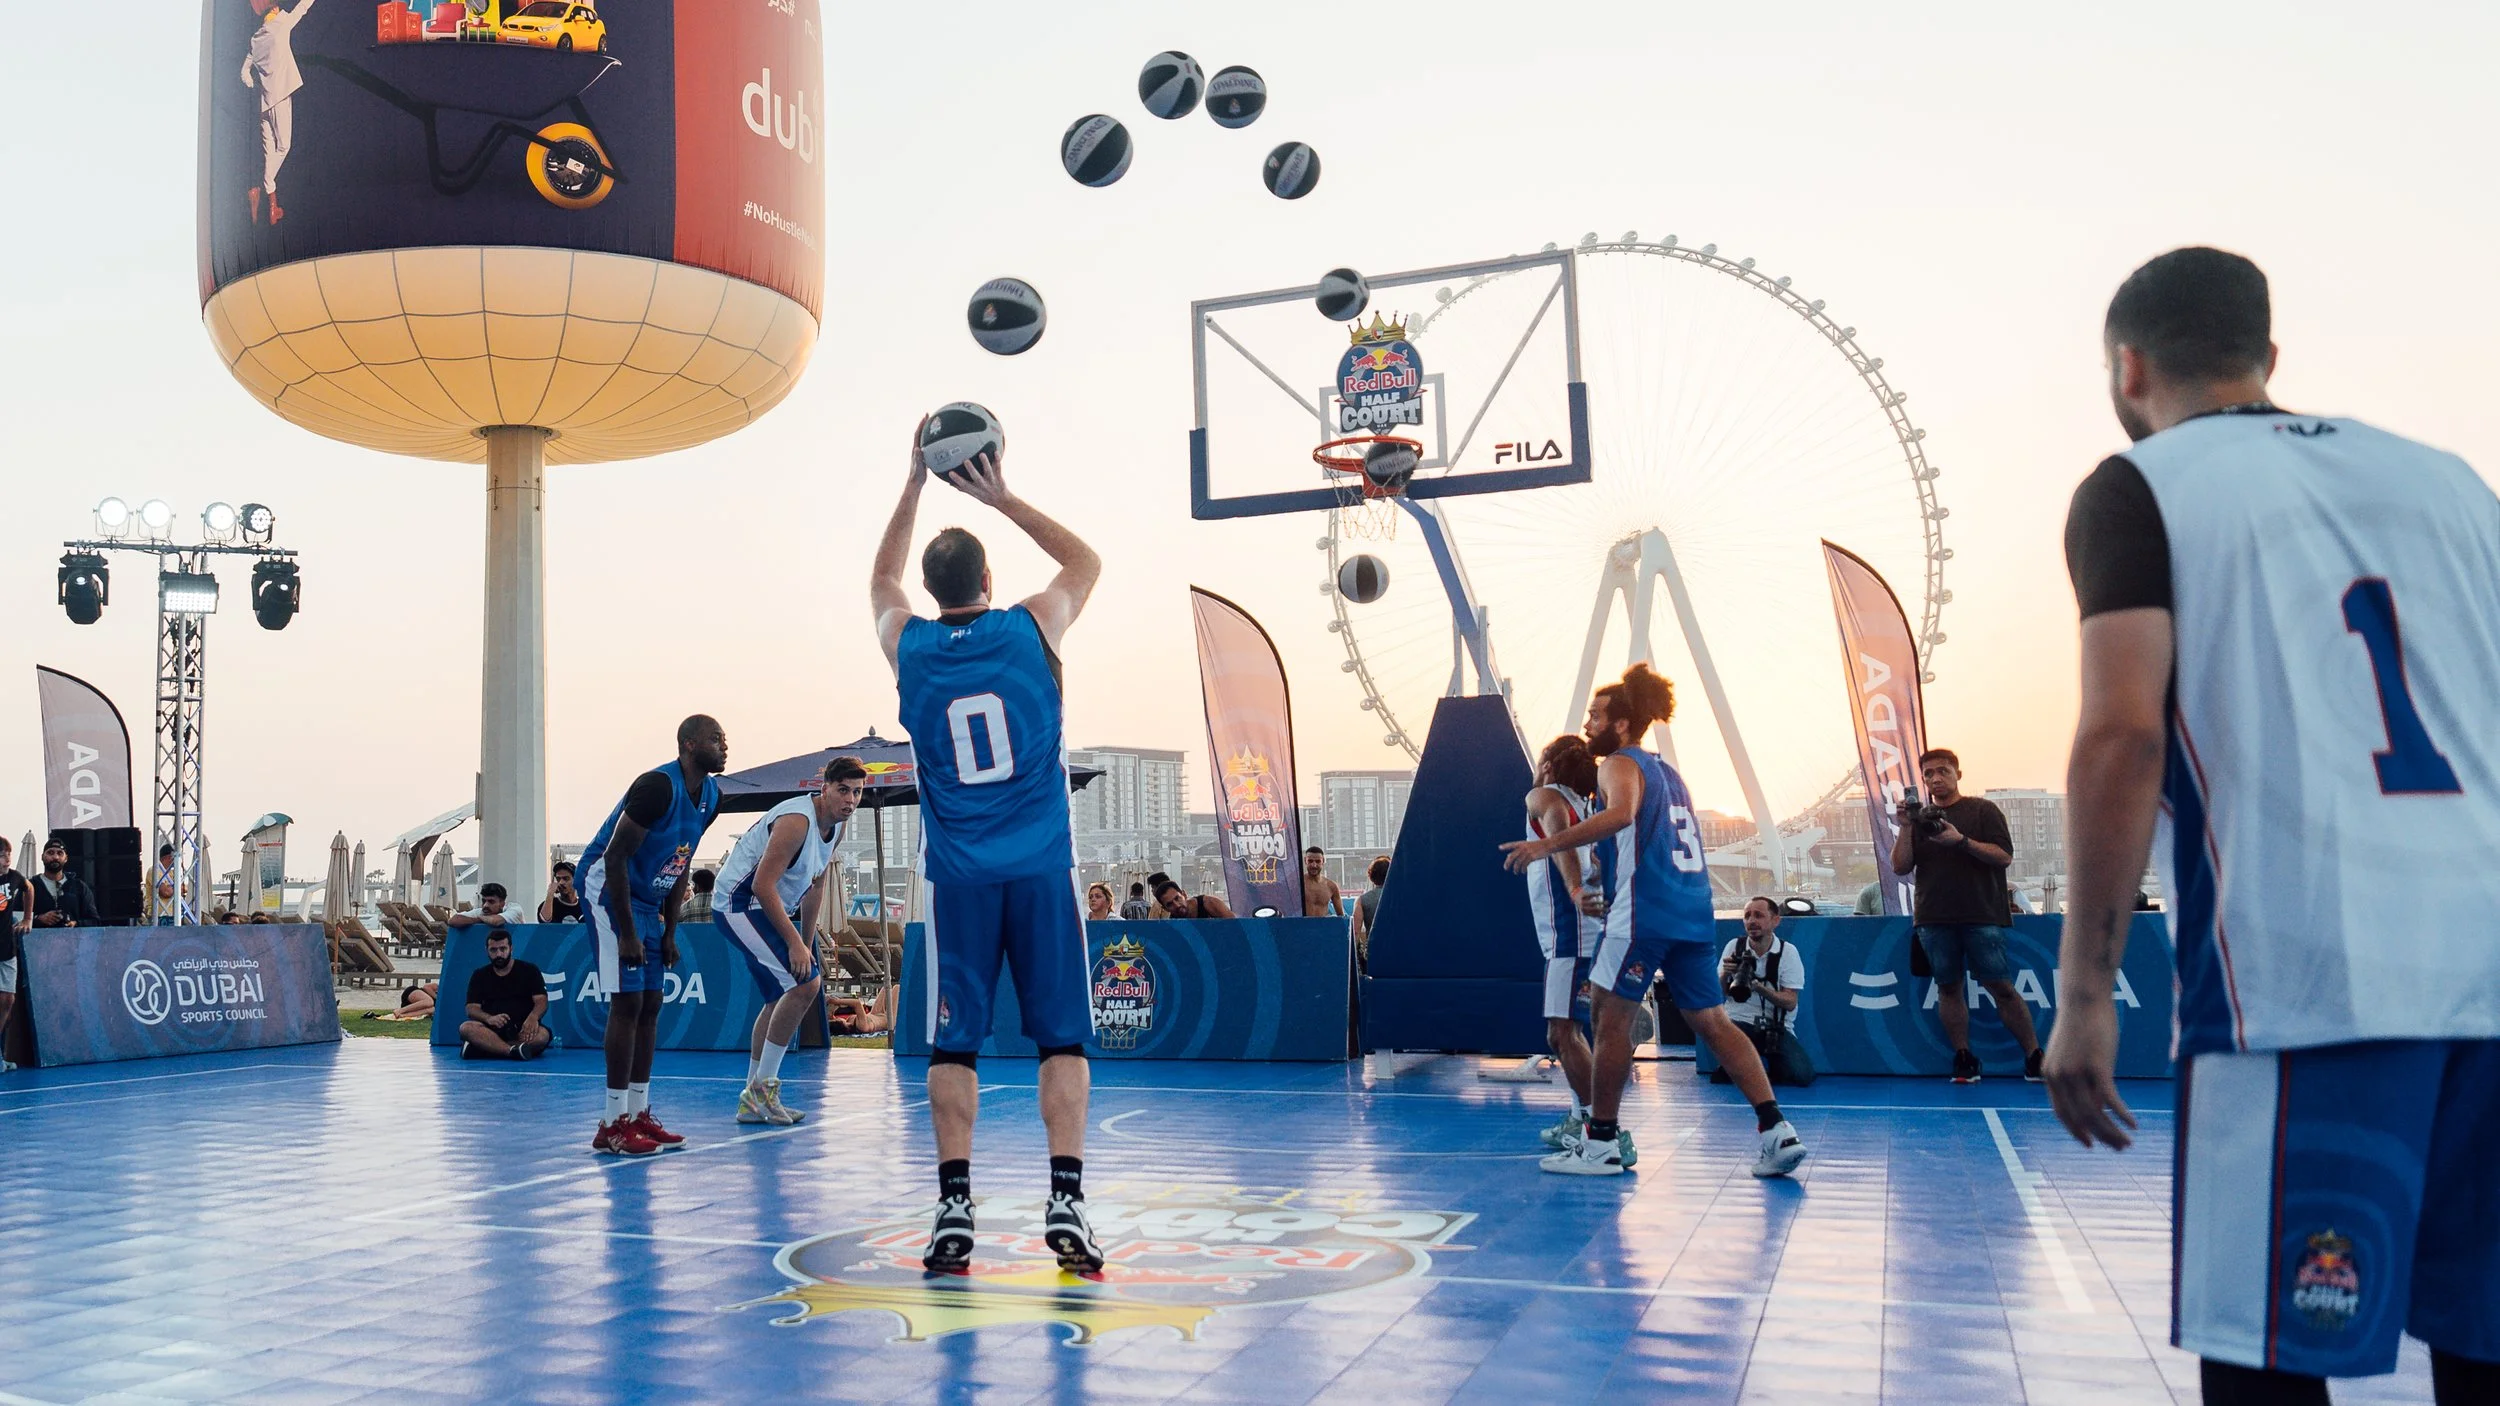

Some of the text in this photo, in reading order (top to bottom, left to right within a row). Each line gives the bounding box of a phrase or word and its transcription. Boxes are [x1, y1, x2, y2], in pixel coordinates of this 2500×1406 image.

[1344, 368, 1415, 393] Red Bull
[1361, 392, 1400, 407] HALF
[1341, 398, 1421, 431] COURT
[1494, 439, 1563, 464] FILA
[2341, 575, 2464, 795] 1
[946, 691, 1015, 785] 0
[1668, 805, 1703, 872] 3
[172, 957, 260, 973] مجلس دبي الرياضي
[174, 973, 265, 1006] DUBAI
[576, 972, 707, 1004] ADA
[1094, 982, 1150, 997] Red Bull
[181, 1008, 268, 1023] SPORTS COUNCIL
[1093, 1007, 1151, 1027] COURT
[1106, 1000, 1136, 1009] HALF
[1107, 1239, 1375, 1271] Red
